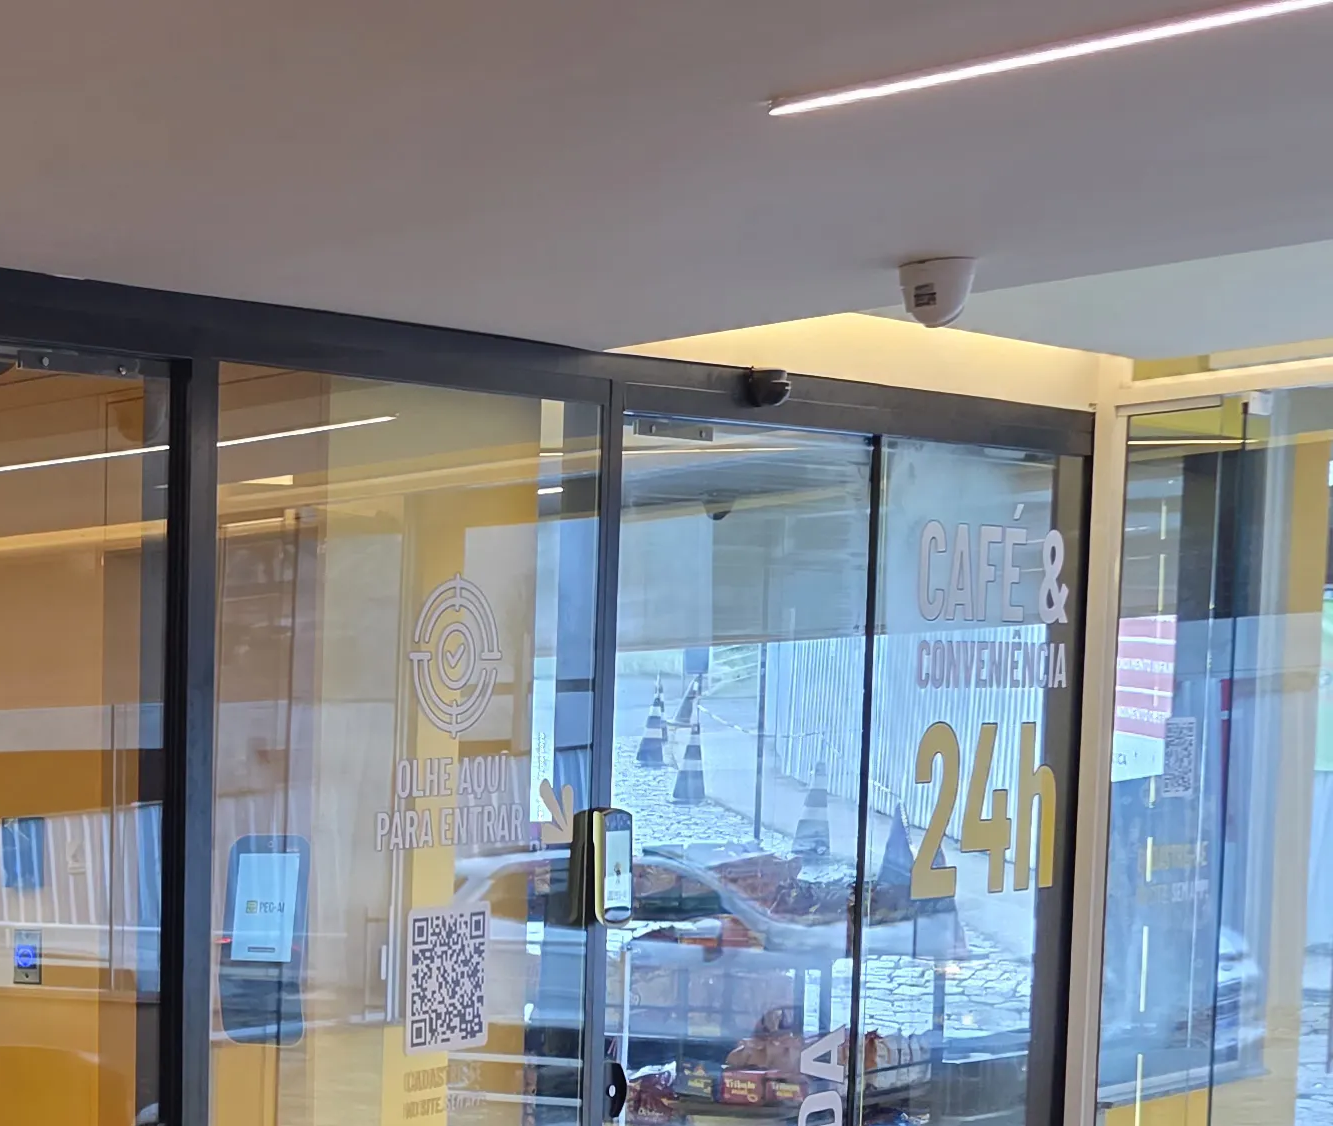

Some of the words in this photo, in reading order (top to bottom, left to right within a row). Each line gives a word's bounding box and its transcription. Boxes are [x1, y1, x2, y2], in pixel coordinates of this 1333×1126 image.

[917, 503, 1027, 624] CAFÉ
[1038, 530, 1069, 625] &
[916, 629, 1067, 690] CONVENIÊNCIA
[396, 757, 453, 799] OLHE
[375, 809, 434, 851] PARA
[439, 802, 525, 847] ENTRAR
[910, 720, 1057, 901] 24h
